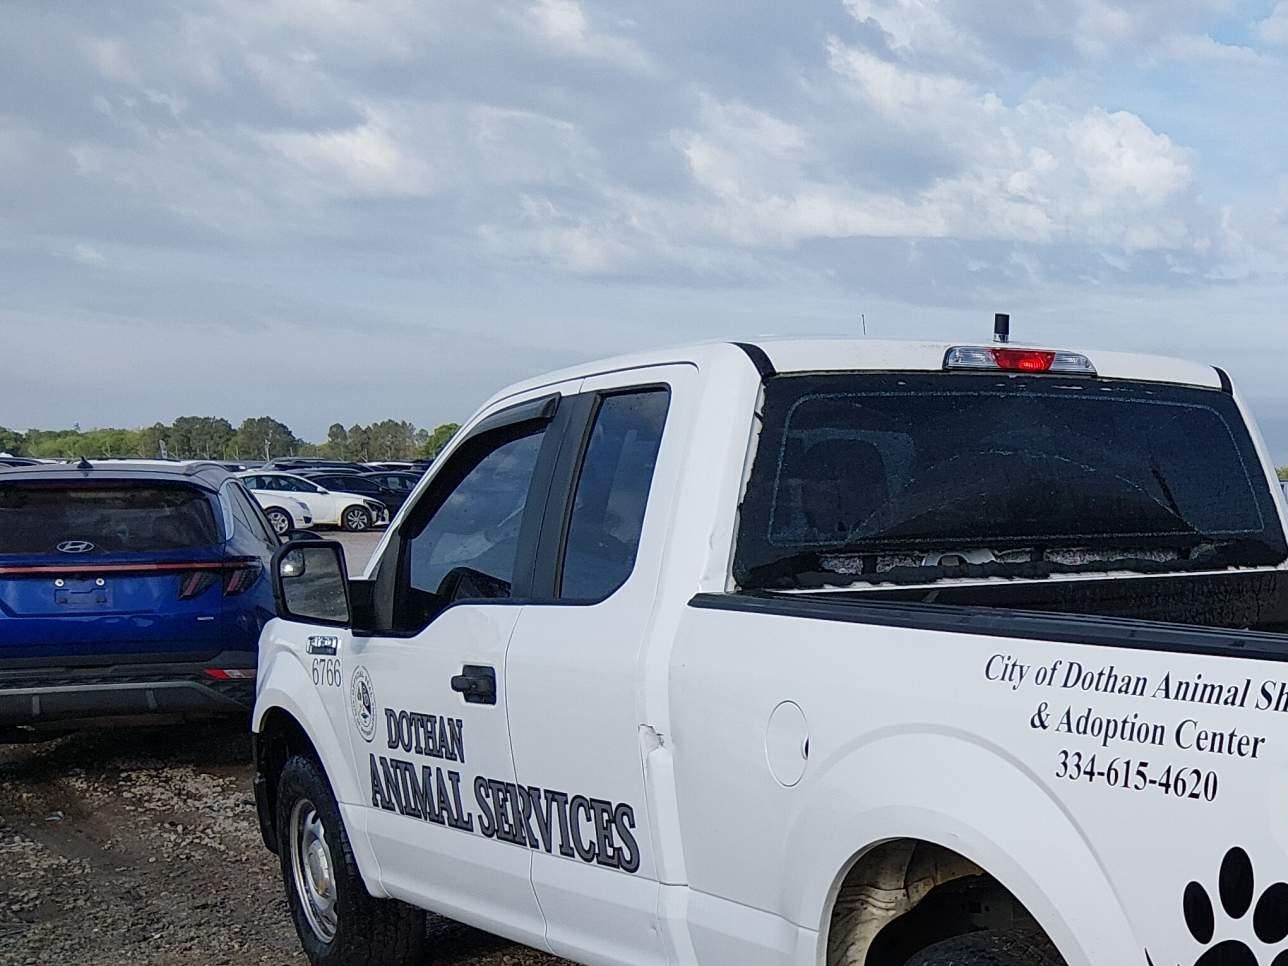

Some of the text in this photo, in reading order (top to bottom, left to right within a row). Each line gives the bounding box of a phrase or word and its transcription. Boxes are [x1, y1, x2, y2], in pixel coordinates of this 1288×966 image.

[311, 658, 342, 687] 6766
[984, 653, 1031, 691] City
[1034, 660, 1062, 687] of
[1063, 662, 1148, 698] Dothan
[1151, 672, 1252, 709] Animal
[384, 708, 465, 764] DOTHAN
[1030, 702, 1266, 759] & Adoption Center
[1055, 750, 1219, 803] 334-615-4620
[368, 753, 641, 874] ANIMAL SERVICES
